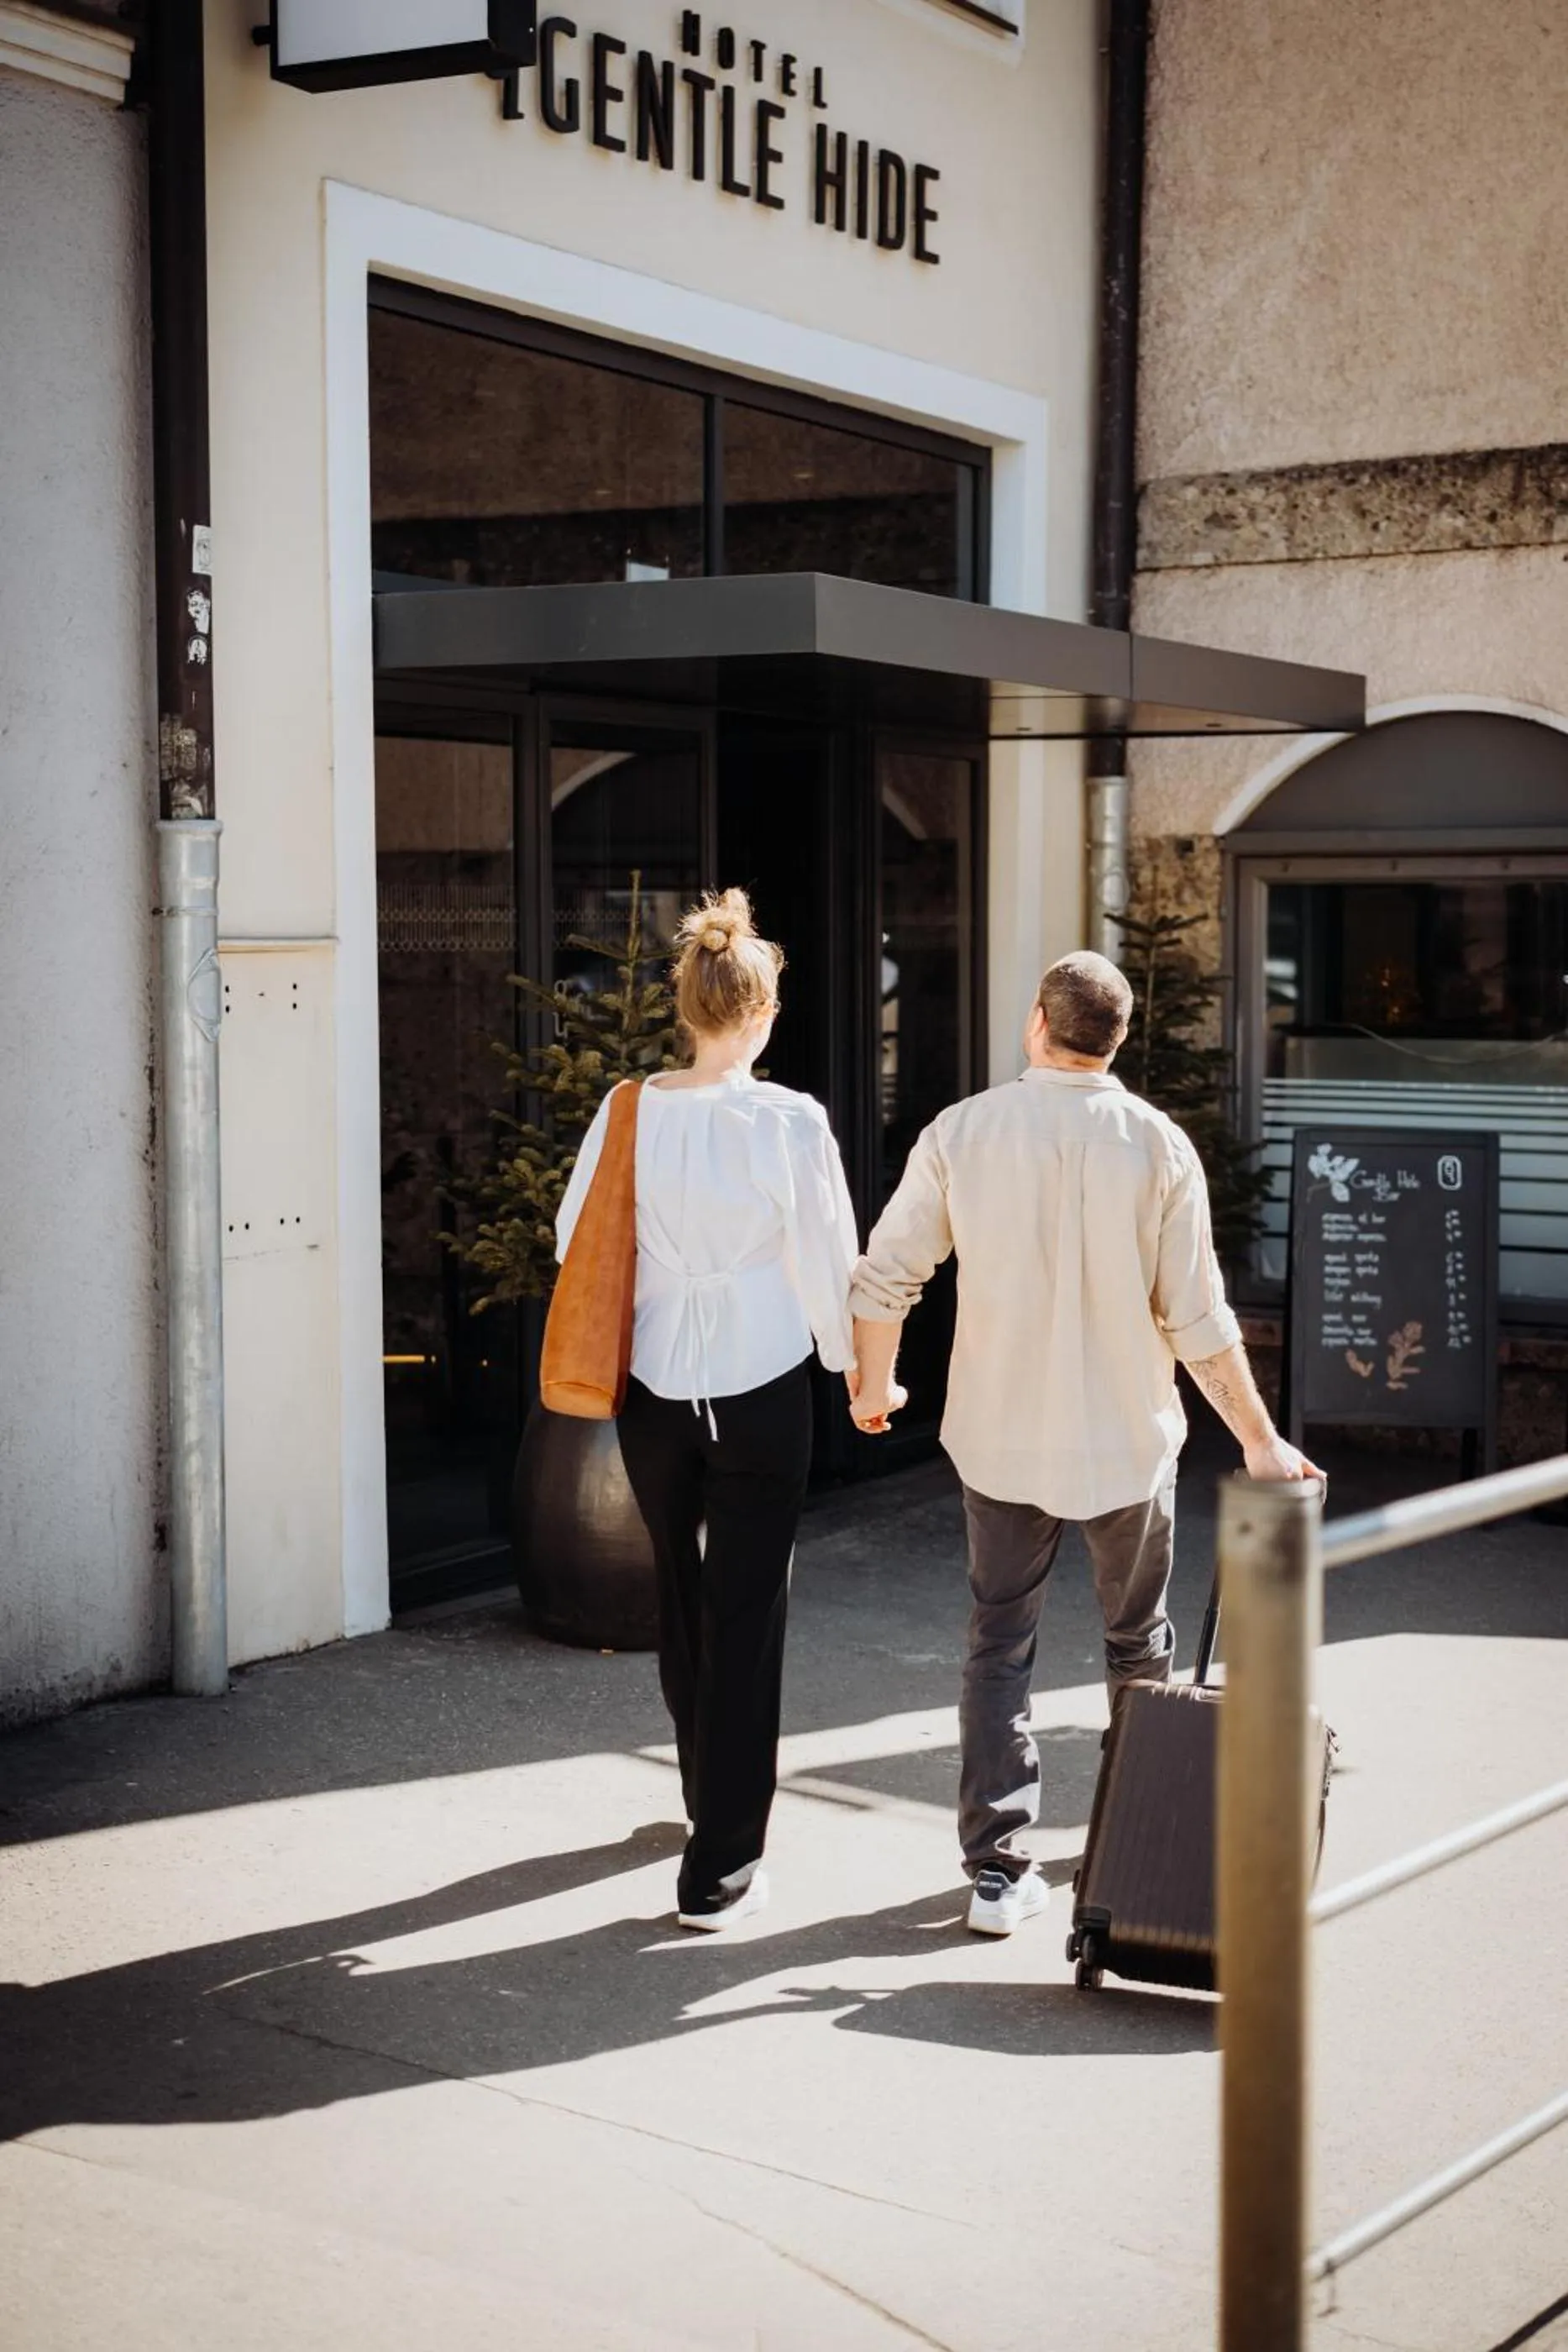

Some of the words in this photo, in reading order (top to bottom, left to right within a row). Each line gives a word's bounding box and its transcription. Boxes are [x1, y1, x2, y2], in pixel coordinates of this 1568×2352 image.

[540, 17, 785, 210] GENTLE
[815, 123, 941, 265] HIDE
[682, 10, 827, 108] HOTEL
